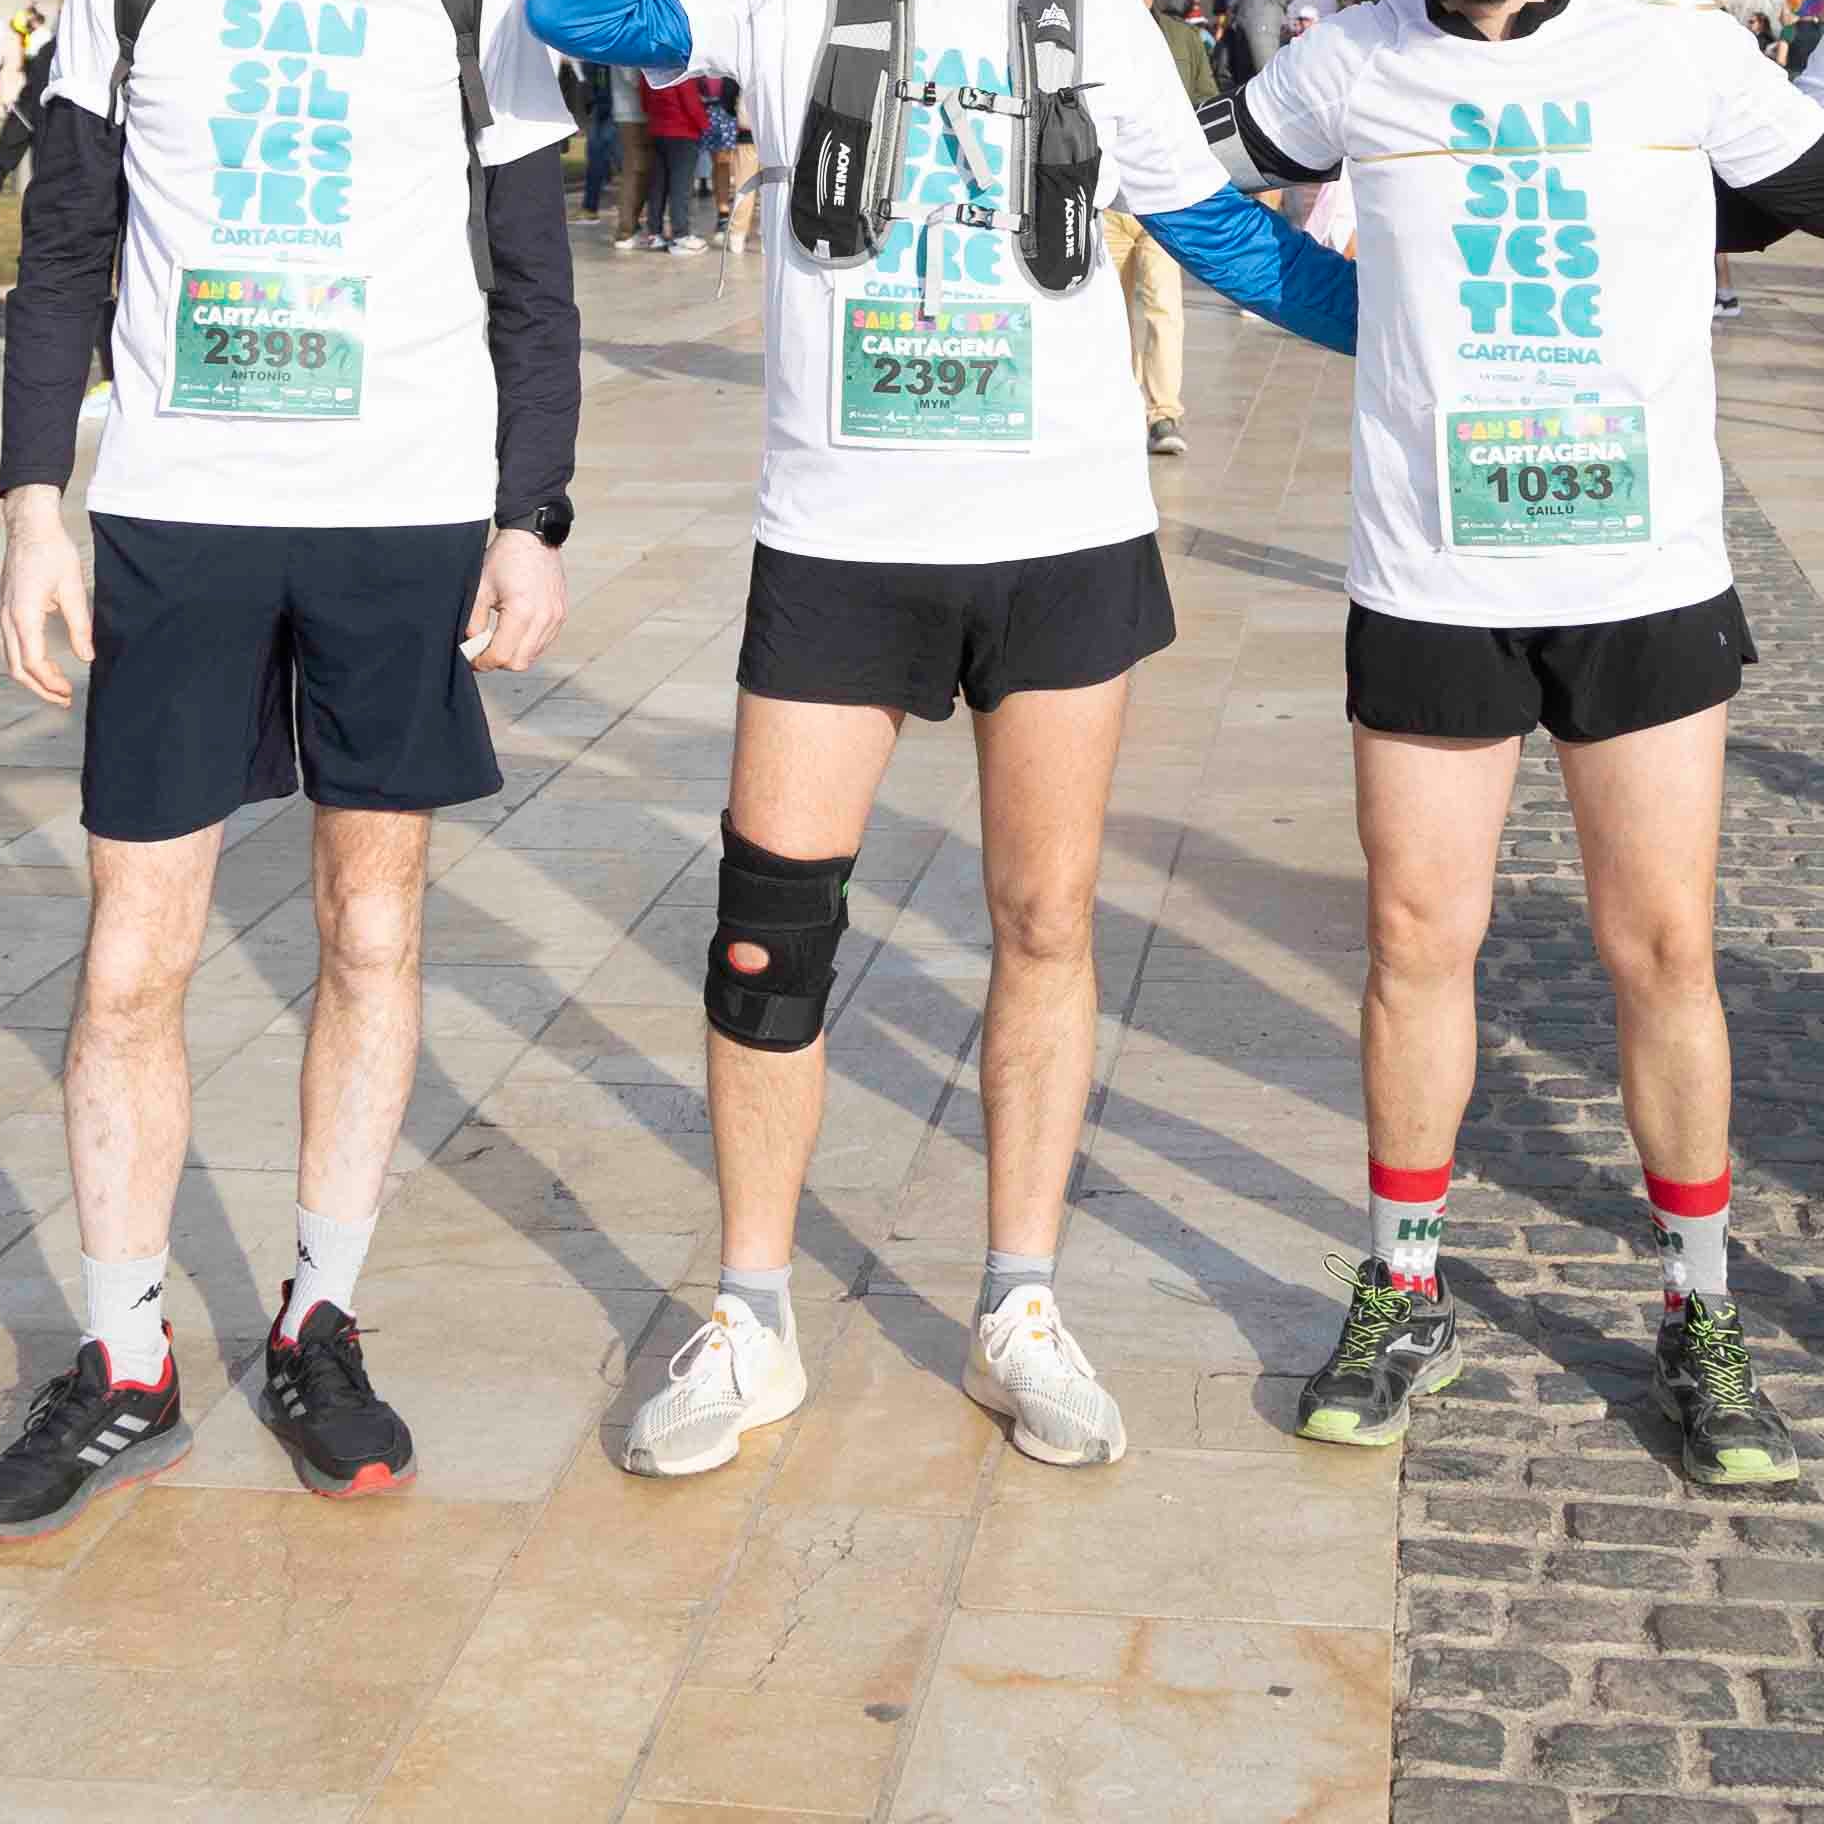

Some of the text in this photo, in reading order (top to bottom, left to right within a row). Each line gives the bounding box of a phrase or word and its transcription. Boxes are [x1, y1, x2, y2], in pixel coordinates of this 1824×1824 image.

[208, 117, 352, 172] VES
[1450, 102, 1592, 156] SAN
[213, 170, 352, 225] TRE
[210, 227, 344, 249] CARTAGENA
[1452, 224, 1599, 279] VES
[1459, 281, 1602, 338] TRE
[204, 328, 327, 369] 2398
[862, 336, 1012, 357] CARTAGENA
[1458, 342, 1601, 365] CARTAGENA
[231, 369, 292, 383] ANTONIO
[873, 357, 999, 395] 2397
[919, 399, 950, 409] MYM
[1469, 441, 1627, 465] CARTAGENA
[1487, 464, 1614, 503] 1033
